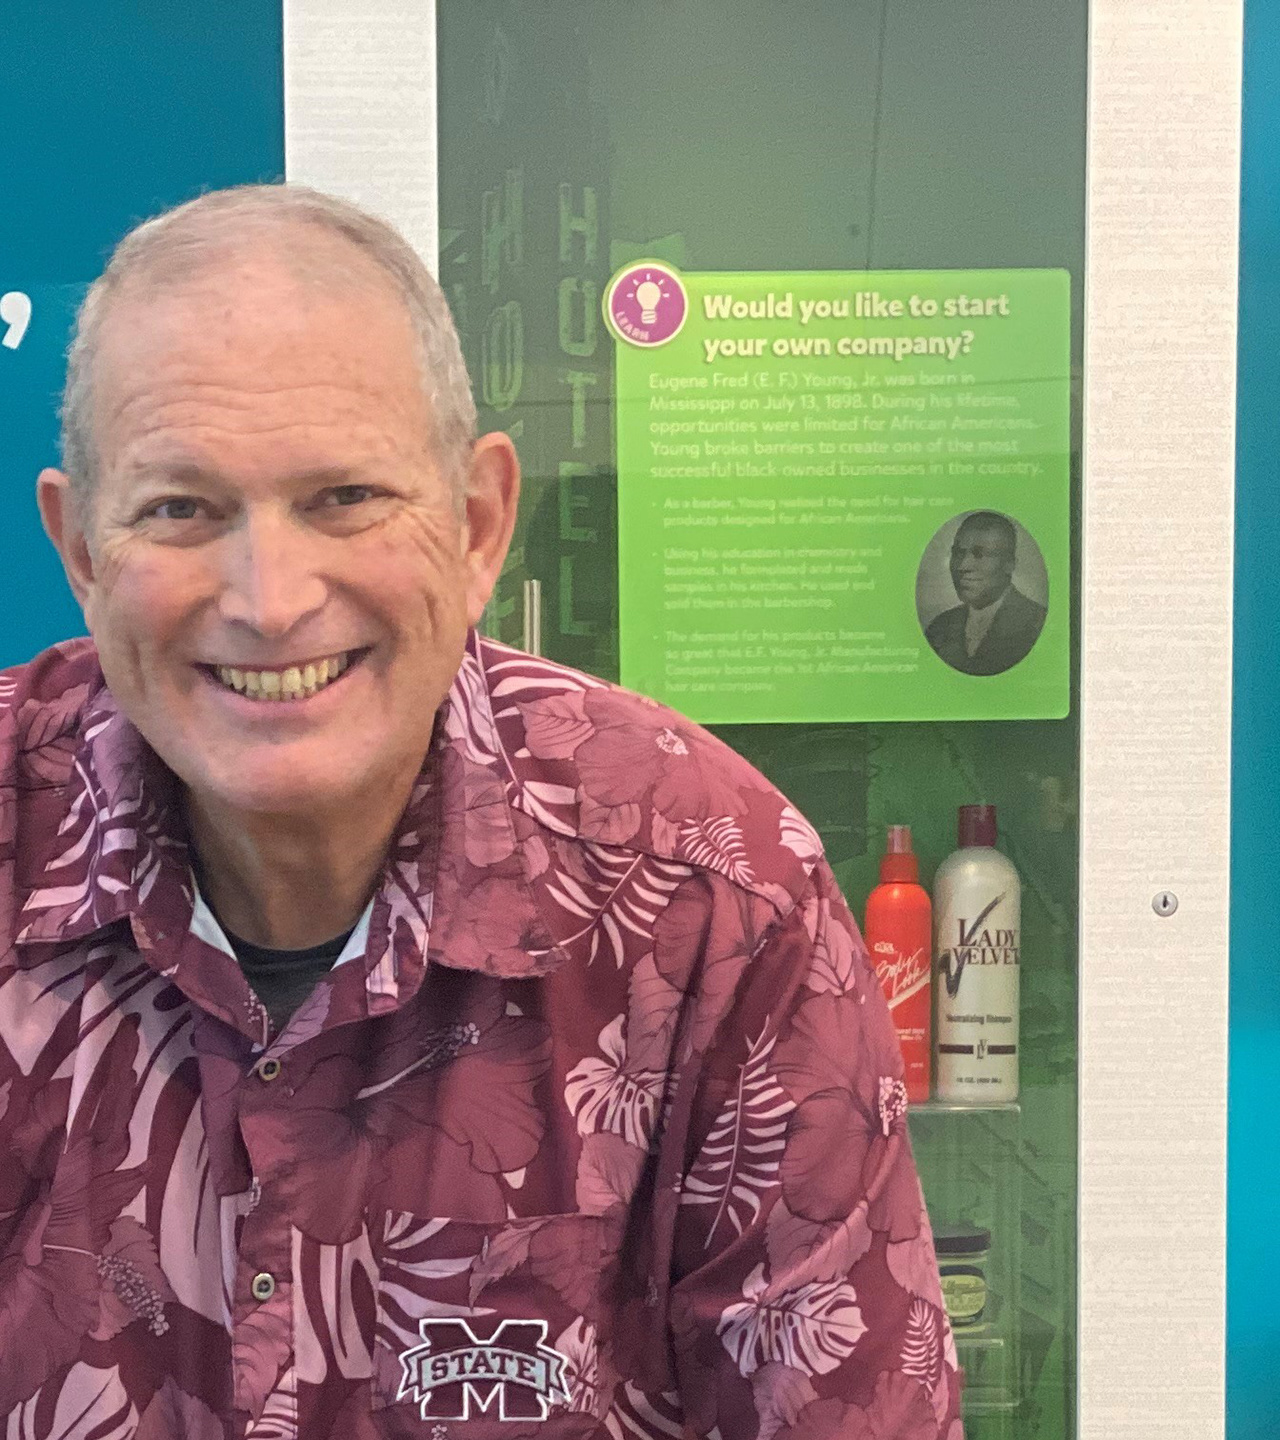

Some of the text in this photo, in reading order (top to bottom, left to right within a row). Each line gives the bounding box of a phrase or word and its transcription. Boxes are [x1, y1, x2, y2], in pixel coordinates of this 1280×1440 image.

[703, 293, 1009, 324] Would you like to start
[703, 331, 974, 363] your own company?
[649, 373, 708, 392] Eugene
[713, 373, 748, 388] Fred
[649, 396, 736, 414] Mississippi
[763, 395, 795, 413] July
[649, 420, 757, 435] opportunities
[762, 420, 800, 432] were
[957, 917, 1017, 947] LADY
[430, 1352, 536, 1382] STATE
